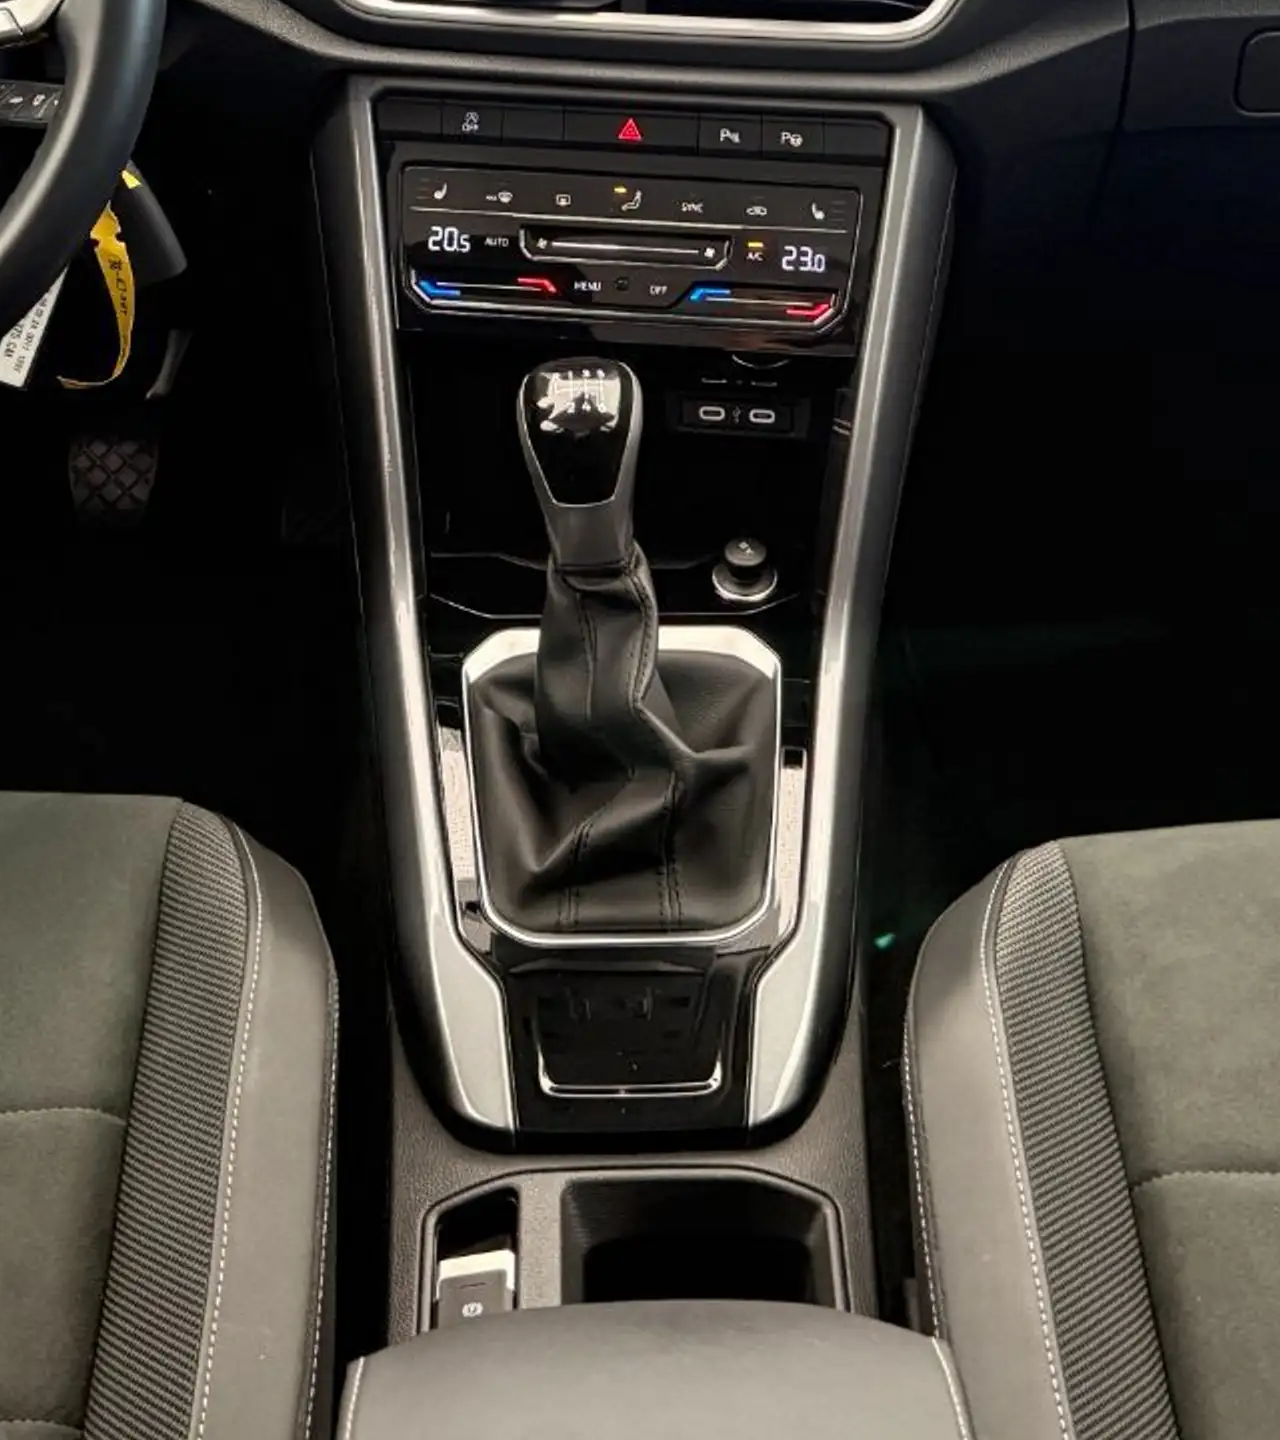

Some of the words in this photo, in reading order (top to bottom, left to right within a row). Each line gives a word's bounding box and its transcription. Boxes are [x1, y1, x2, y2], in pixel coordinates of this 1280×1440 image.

[681, 202, 704, 214] SYNC
[427, 226, 471, 253] 20.5
[484, 237, 510, 248] AUTO
[746, 250, 764, 262] A/C
[781, 245, 826, 273] 23.0
[573, 280, 602, 292] MENU
[649, 285, 668, 296] OFF
